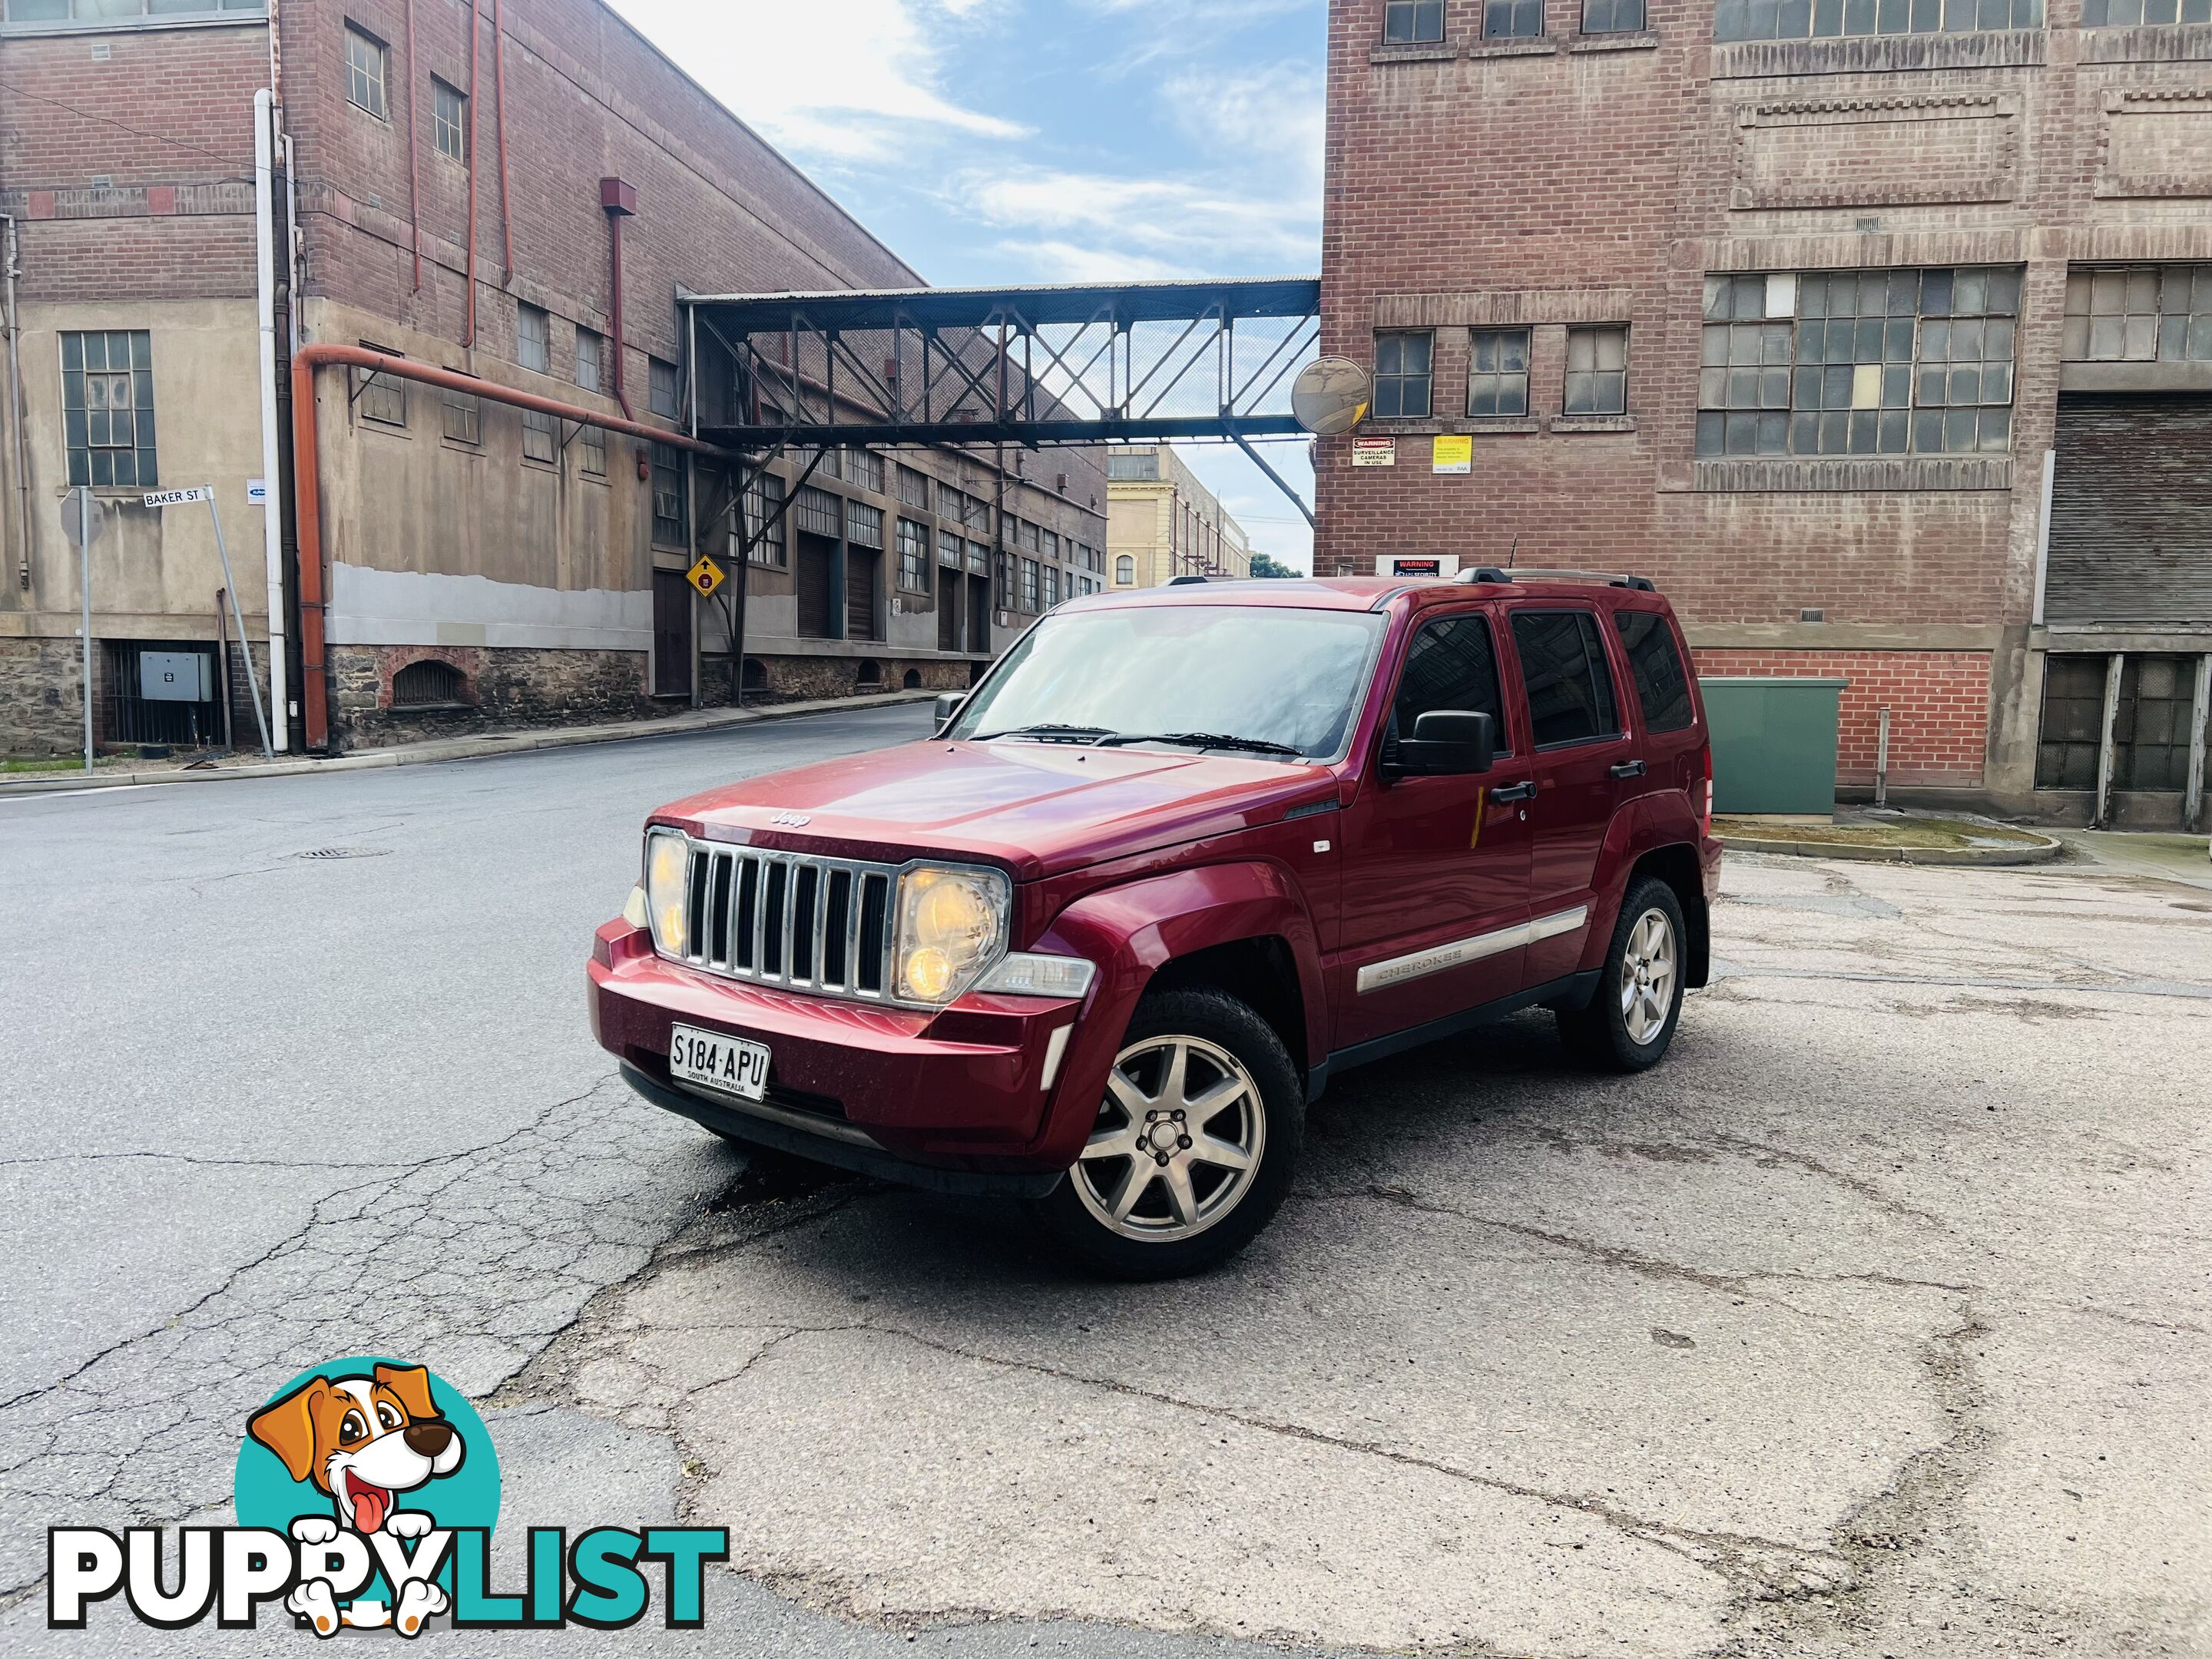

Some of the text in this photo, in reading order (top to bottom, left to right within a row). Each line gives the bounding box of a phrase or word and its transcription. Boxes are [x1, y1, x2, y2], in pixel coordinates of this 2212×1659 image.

[146, 490, 198, 505] BAKER ST
[770, 811, 811, 828] Jeep
[1376, 950, 1462, 980] CHEROKEE
[687, 1071, 745, 1091] SOUTH AUSTRALIA
